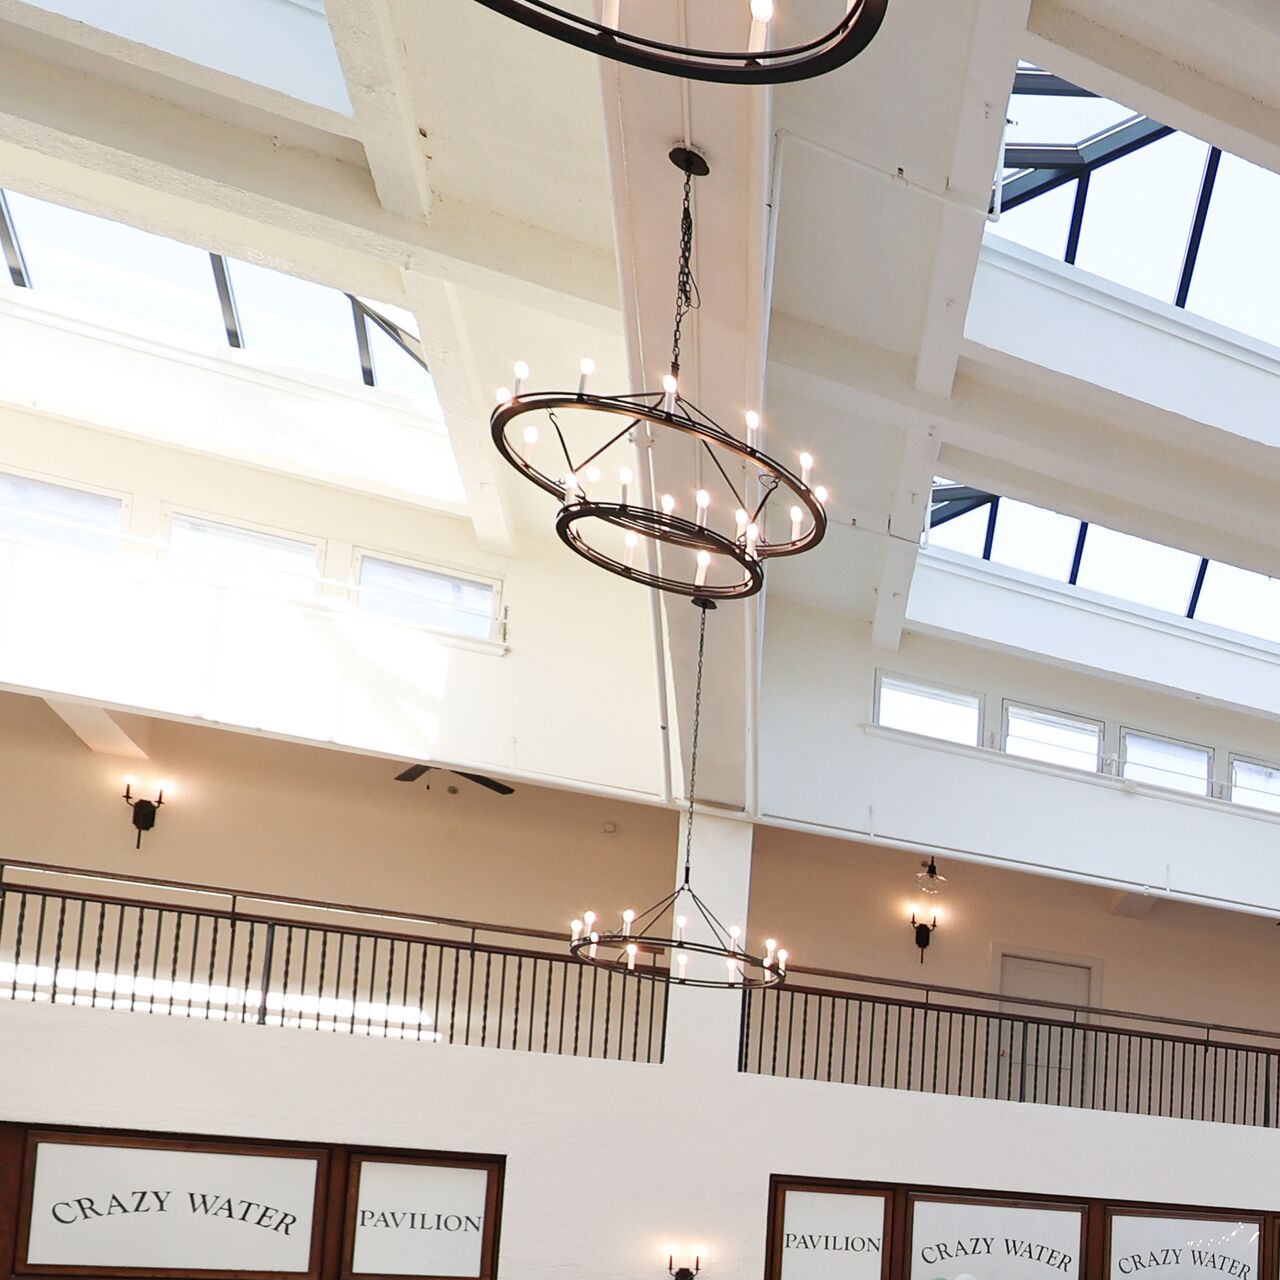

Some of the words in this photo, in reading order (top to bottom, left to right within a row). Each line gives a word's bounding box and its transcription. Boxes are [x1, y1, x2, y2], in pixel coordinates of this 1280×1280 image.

[51, 1190, 172, 1224] CRAZY
[188, 1191, 297, 1236] WATER
[359, 1209, 482, 1232] PAVILION
[784, 1232, 881, 1253] PAVILION
[921, 1237, 994, 1264] CRAZY
[1003, 1238, 1073, 1273] WATER
[1118, 1248, 1183, 1274] CRAZY
